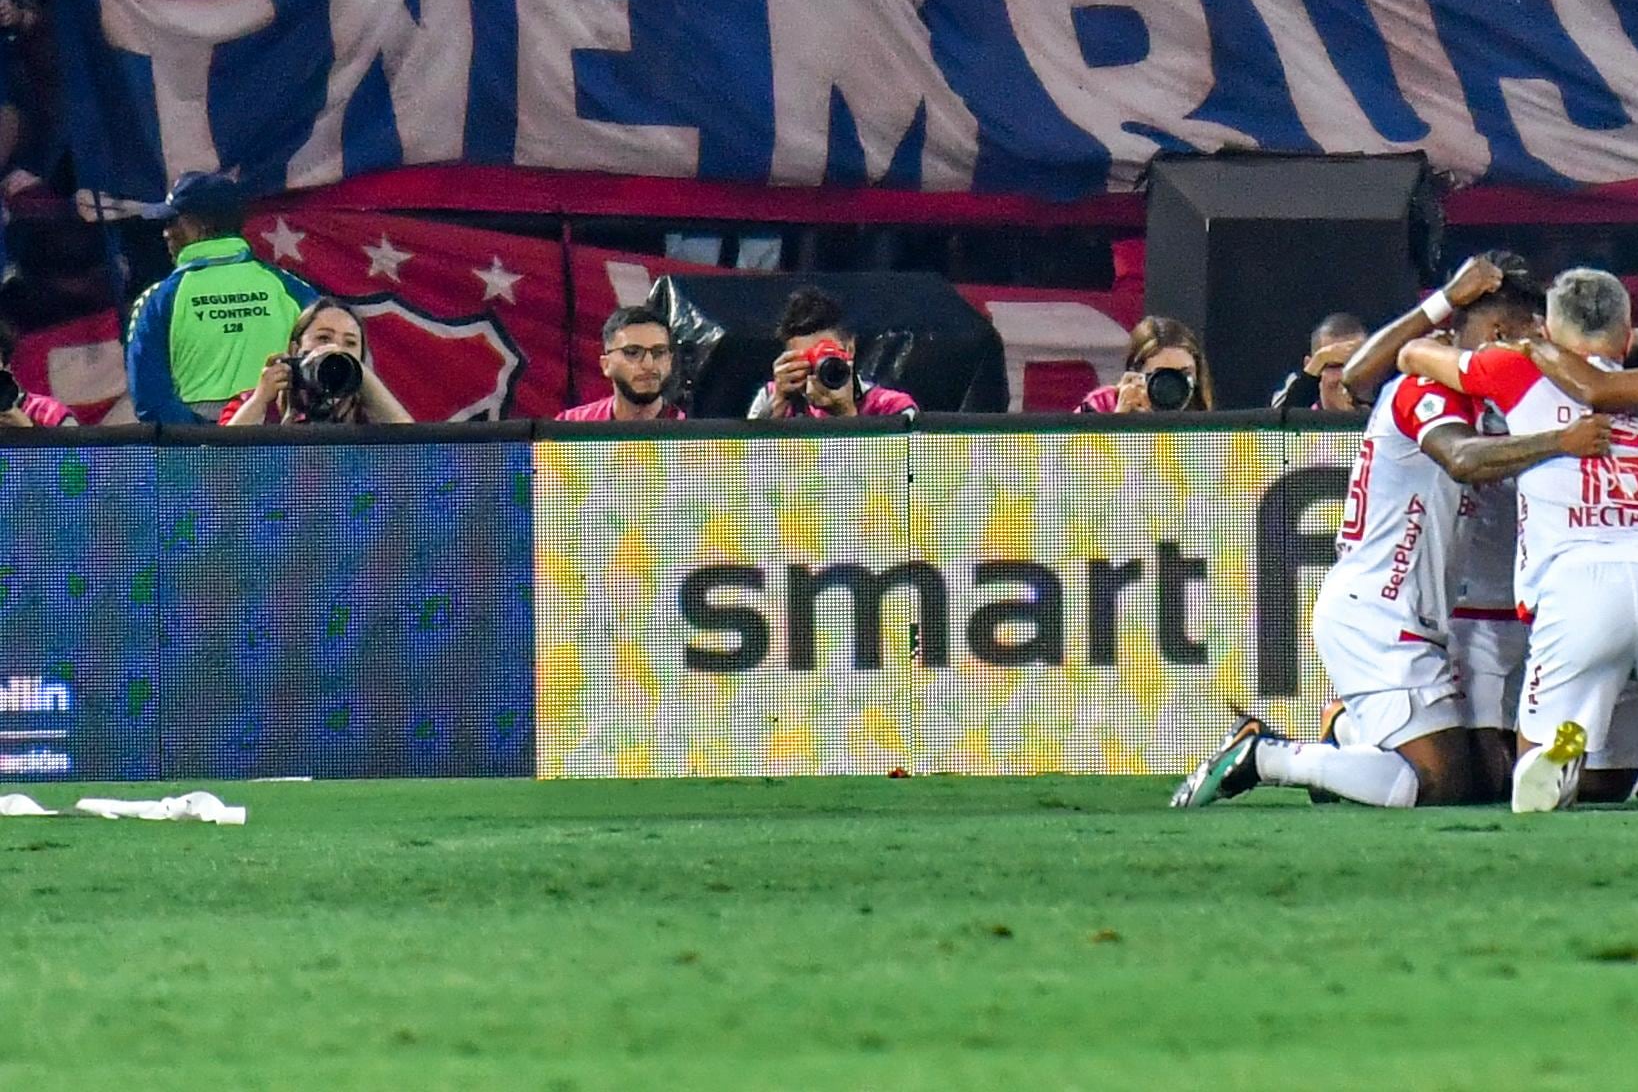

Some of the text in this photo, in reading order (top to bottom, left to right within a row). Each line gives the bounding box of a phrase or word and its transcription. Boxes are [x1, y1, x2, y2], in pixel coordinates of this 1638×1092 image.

[191, 290, 270, 308] SEGURIDAD
[194, 305, 271, 321] Y CONTROL
[223, 321, 244, 334] 128
[1380, 516, 1424, 601] BetPlay
[677, 542, 1210, 674] smart
